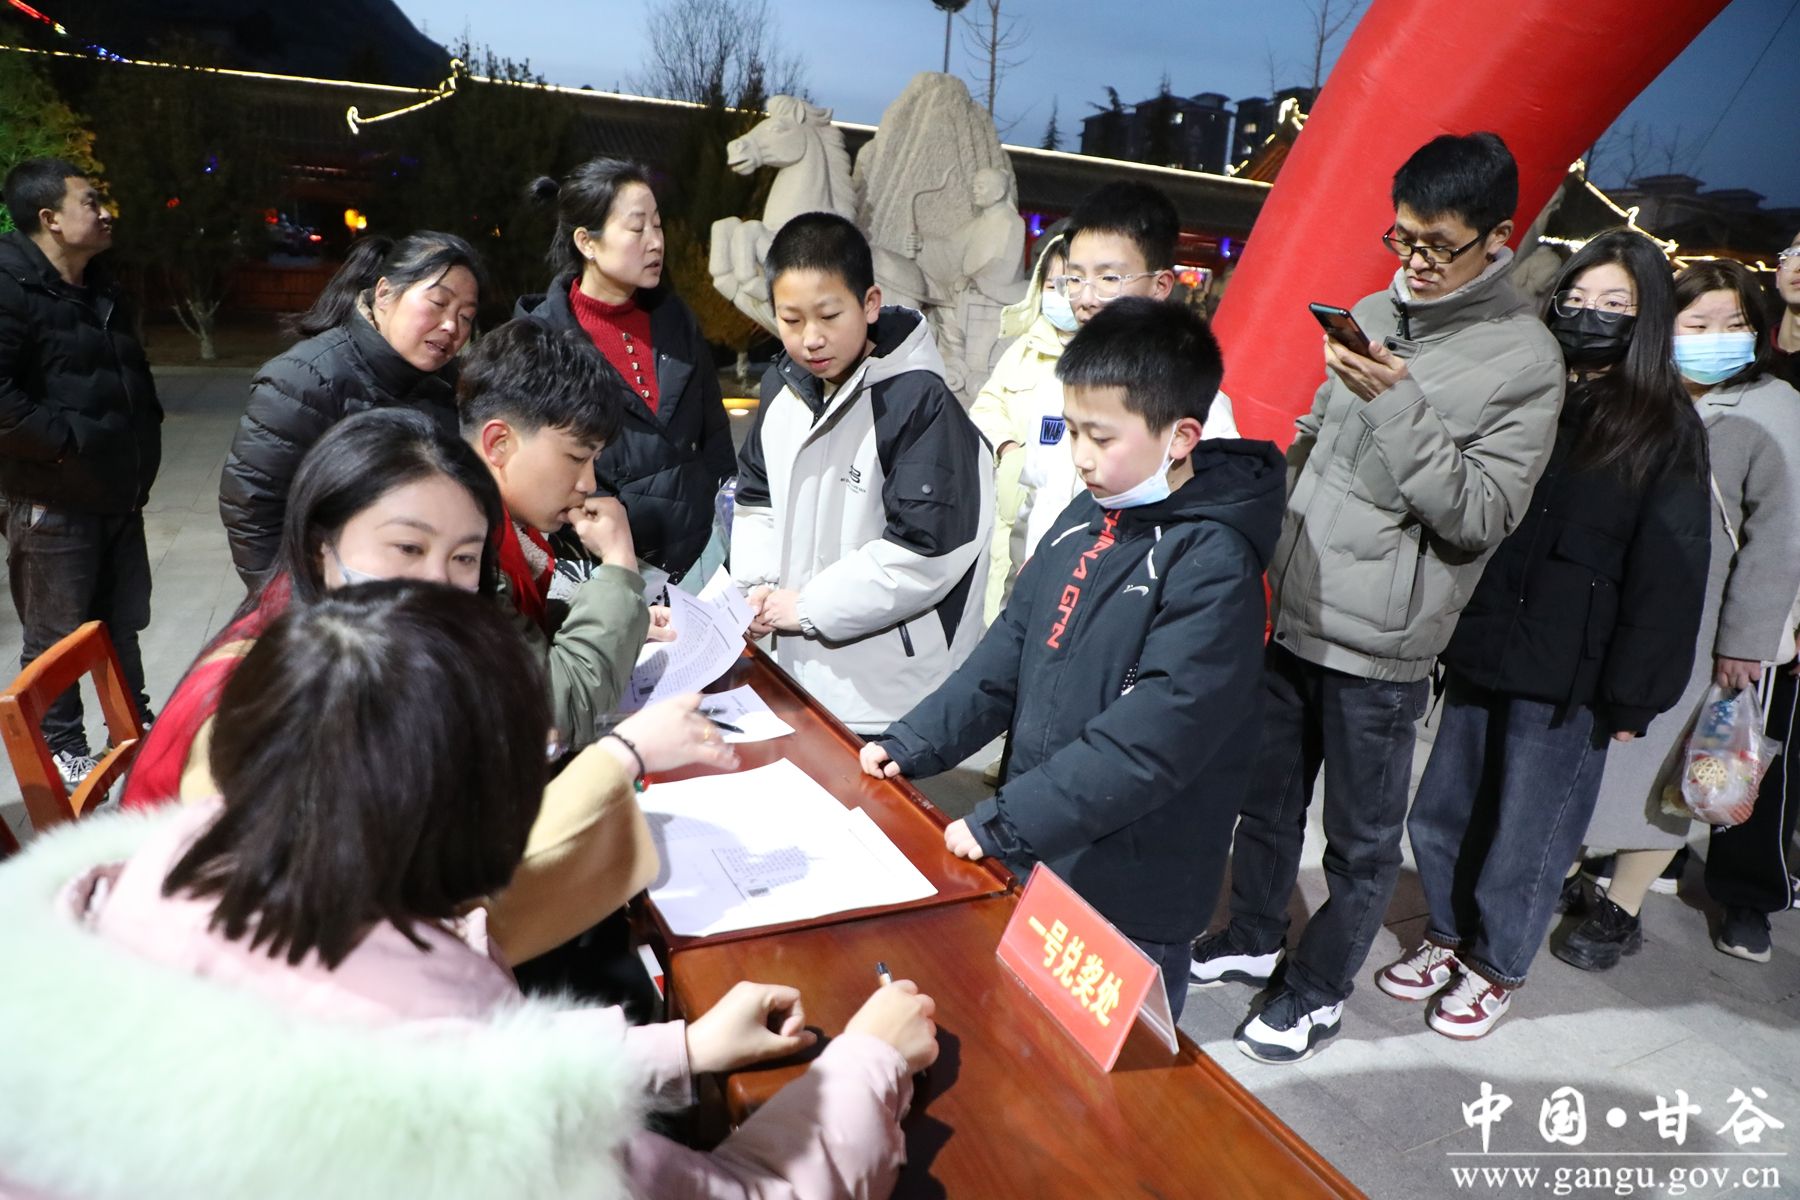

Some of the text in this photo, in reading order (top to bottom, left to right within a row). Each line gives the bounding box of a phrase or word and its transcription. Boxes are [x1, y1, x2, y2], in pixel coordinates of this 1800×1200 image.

[1028, 915, 1123, 1027] 一号兑奖处
